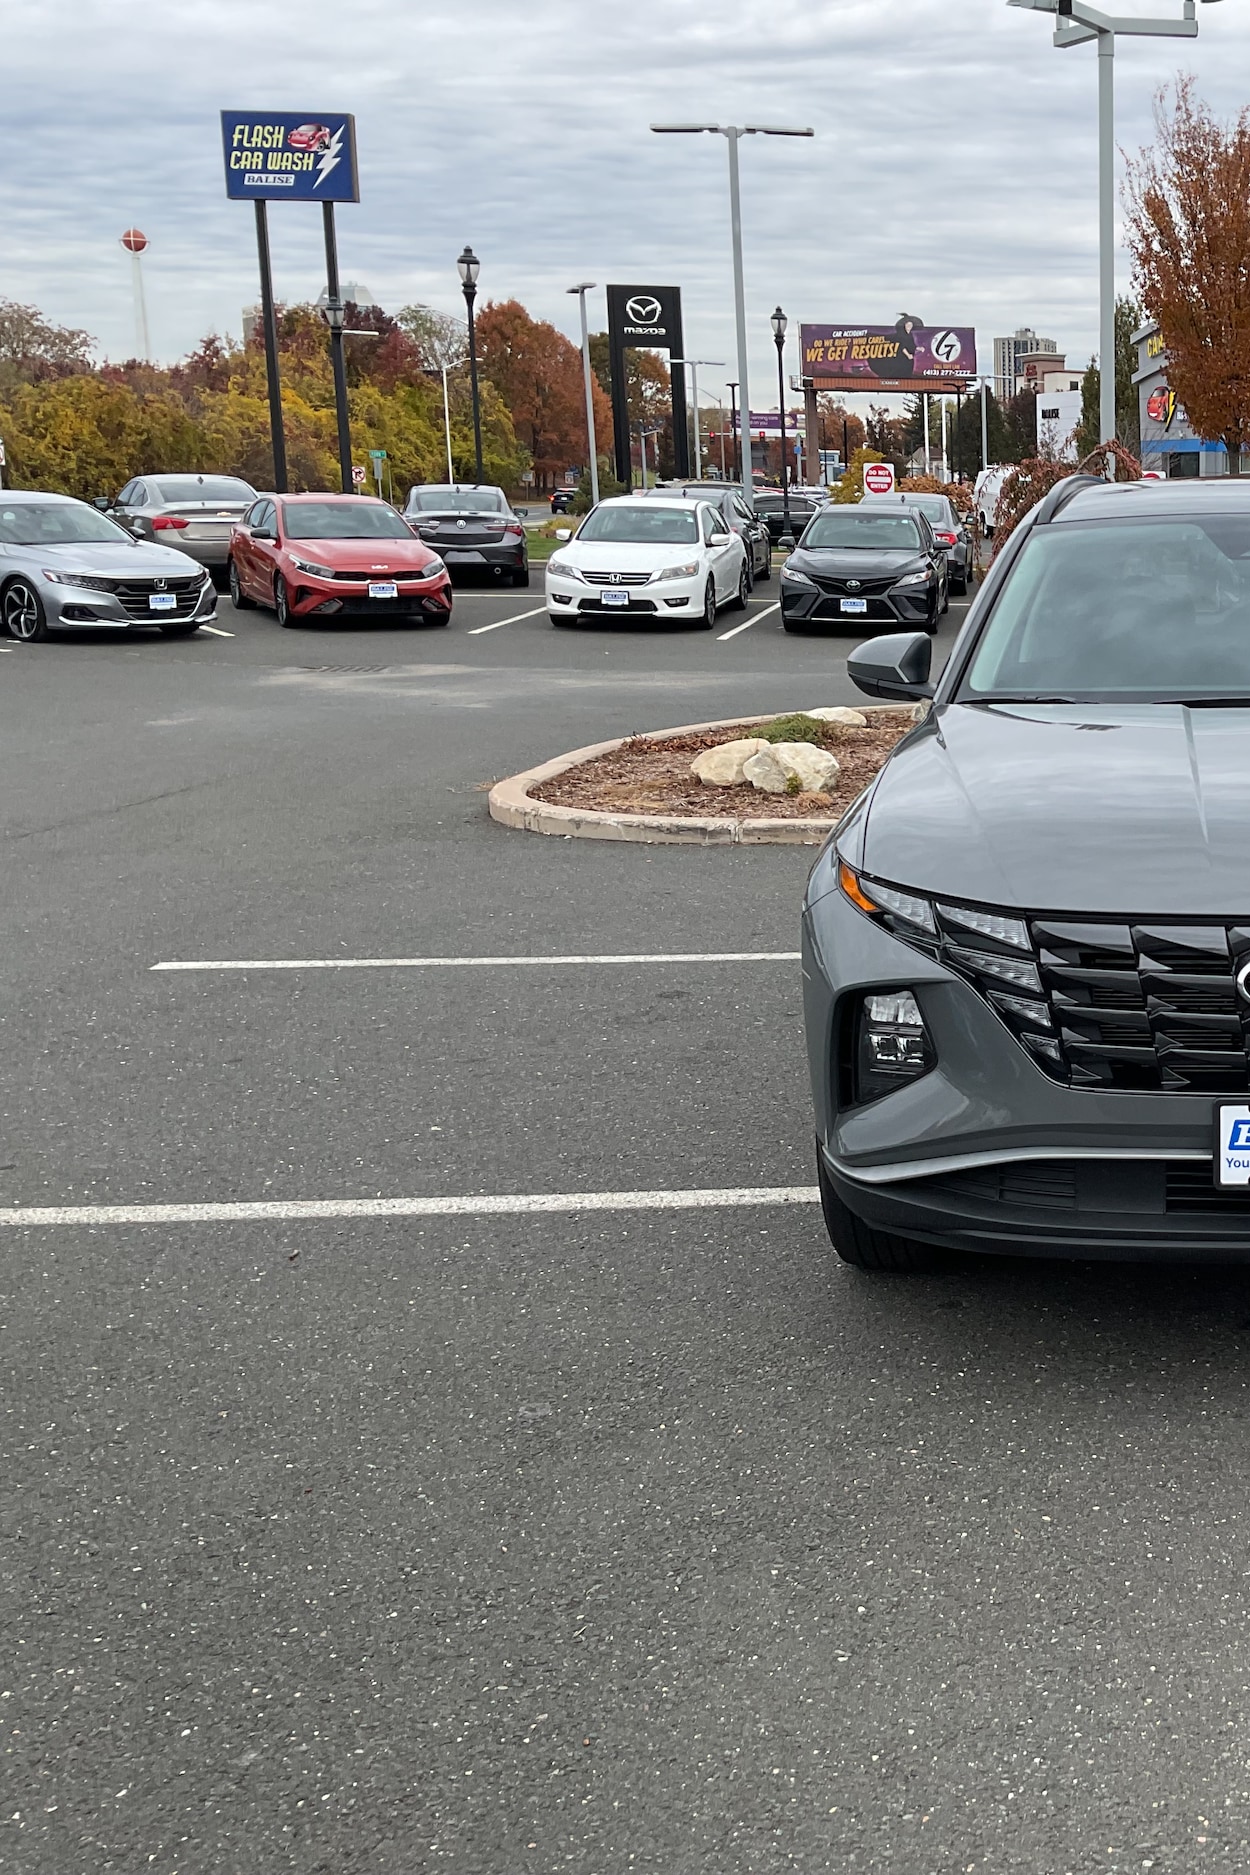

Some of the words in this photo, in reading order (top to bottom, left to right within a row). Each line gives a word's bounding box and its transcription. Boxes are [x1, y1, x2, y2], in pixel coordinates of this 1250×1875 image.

[232, 125, 285, 149] FLASH
[230, 151, 263, 170] CAR
[267, 152, 315, 171] WASH
[247, 175, 293, 184] BALISE
[623, 326, 667, 336] mazda
[832, 330, 841, 338] CAR
[824, 339, 834, 347] WE
[806, 347, 824, 362] WE
[827, 346, 848, 361] GET
[851, 342, 900, 360] RESULTS!
